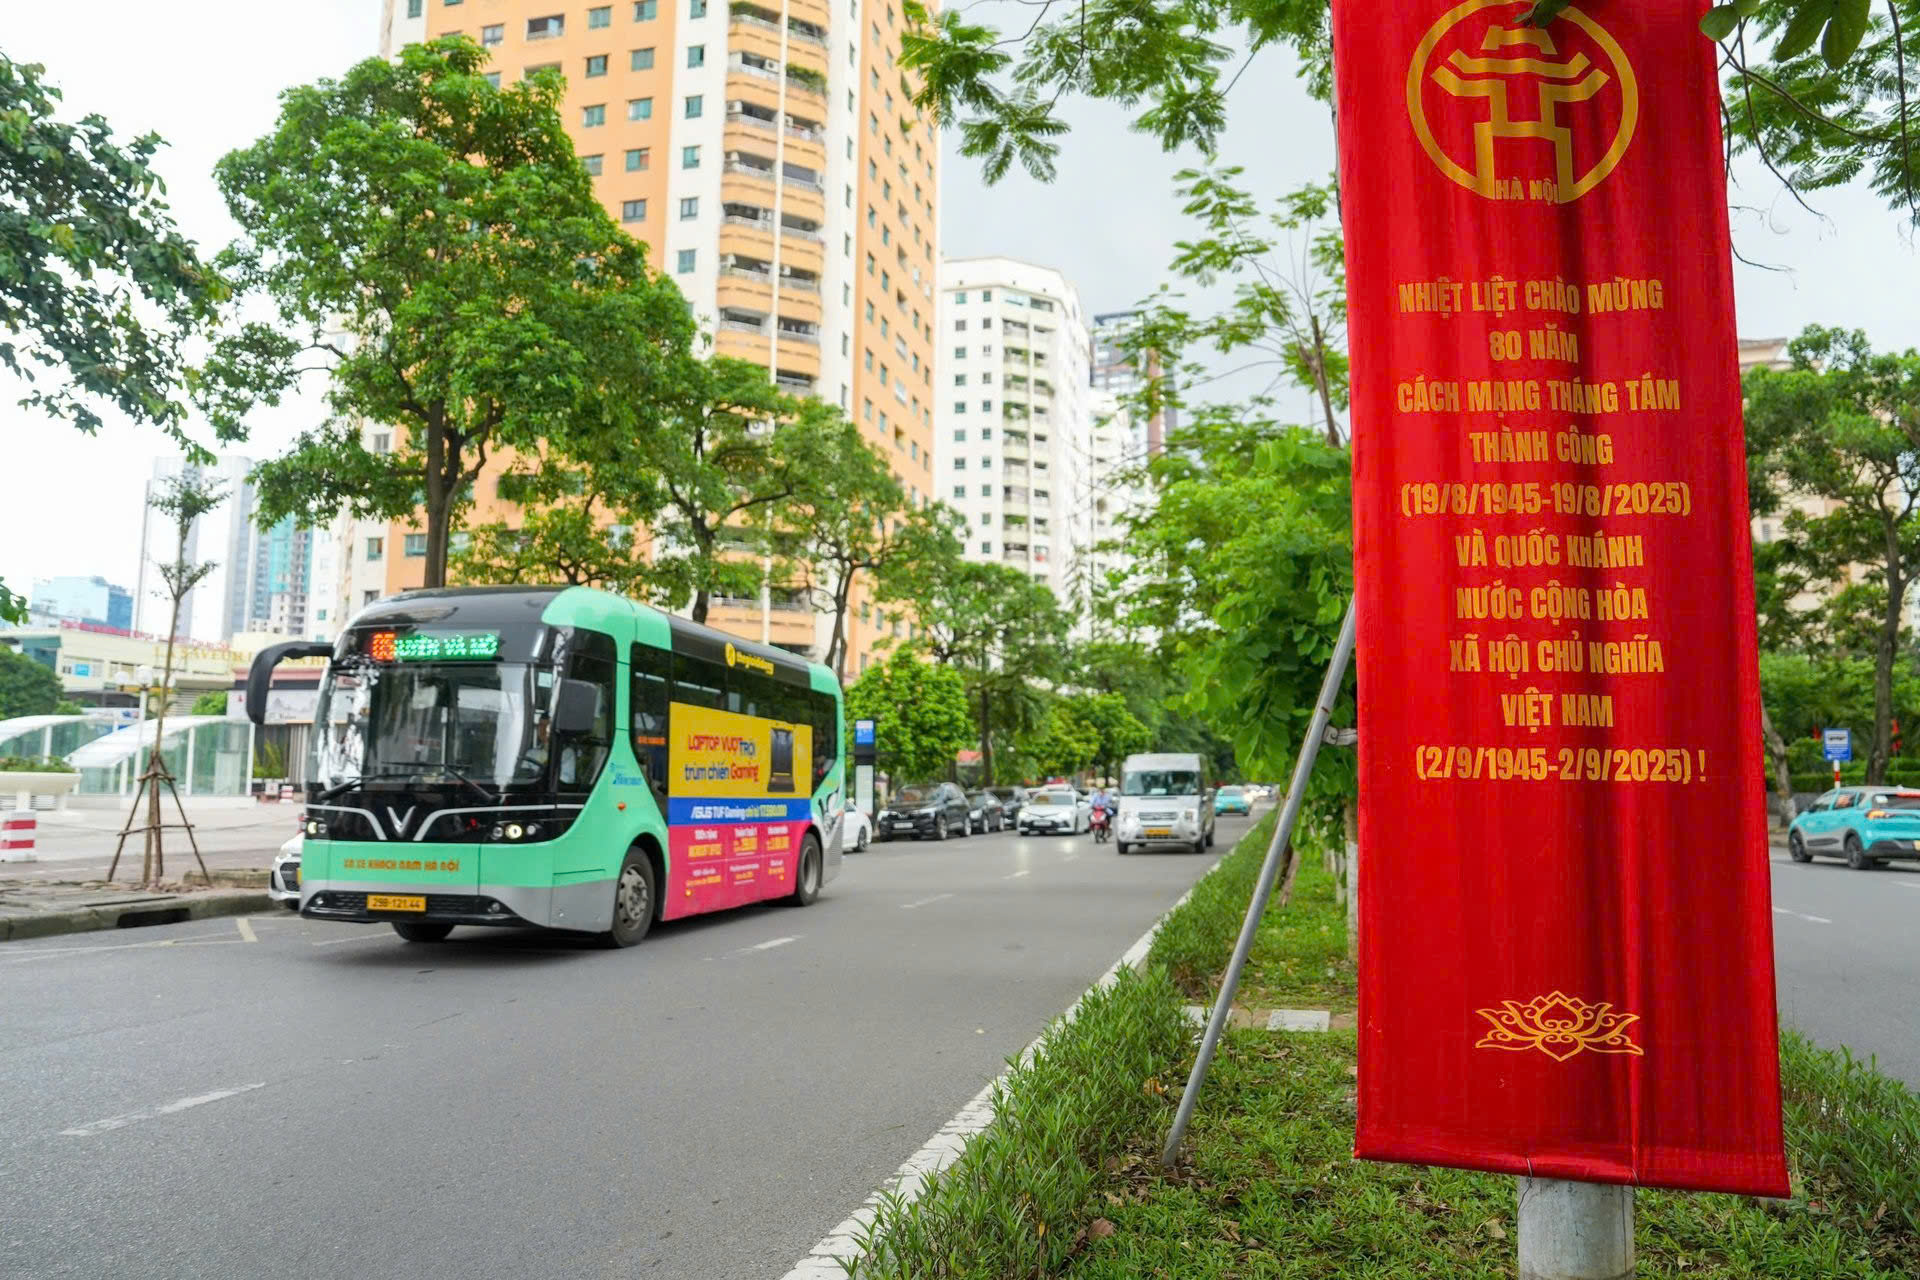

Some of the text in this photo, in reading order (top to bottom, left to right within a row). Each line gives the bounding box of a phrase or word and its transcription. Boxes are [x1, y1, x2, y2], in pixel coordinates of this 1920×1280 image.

[1495, 176, 1559, 206] HÀ NỘI
[1399, 275, 1664, 319] NHIỆT LIỆT CHÀO MỪNG
[1489, 322, 1579, 363] 80 NĂM
[1398, 372, 1681, 418] CÁCH MẠNG THÁNG TÁM
[1469, 424, 1614, 465] THÀNH CÔNG
[1401, 481, 1692, 518] (19/8/1945-19/8/2025)
[1455, 527, 1645, 569] VÀ QUỐC KHÁNH
[1456, 579, 1649, 625] NƯỚC CỘNG HÒA
[1450, 630, 1664, 679] XÃ HỘI CHỦ NGHĨA
[1501, 686, 1614, 733] VIỆT NAM
[1416, 745, 1692, 784] (2/9/1945-2/9/2025)
